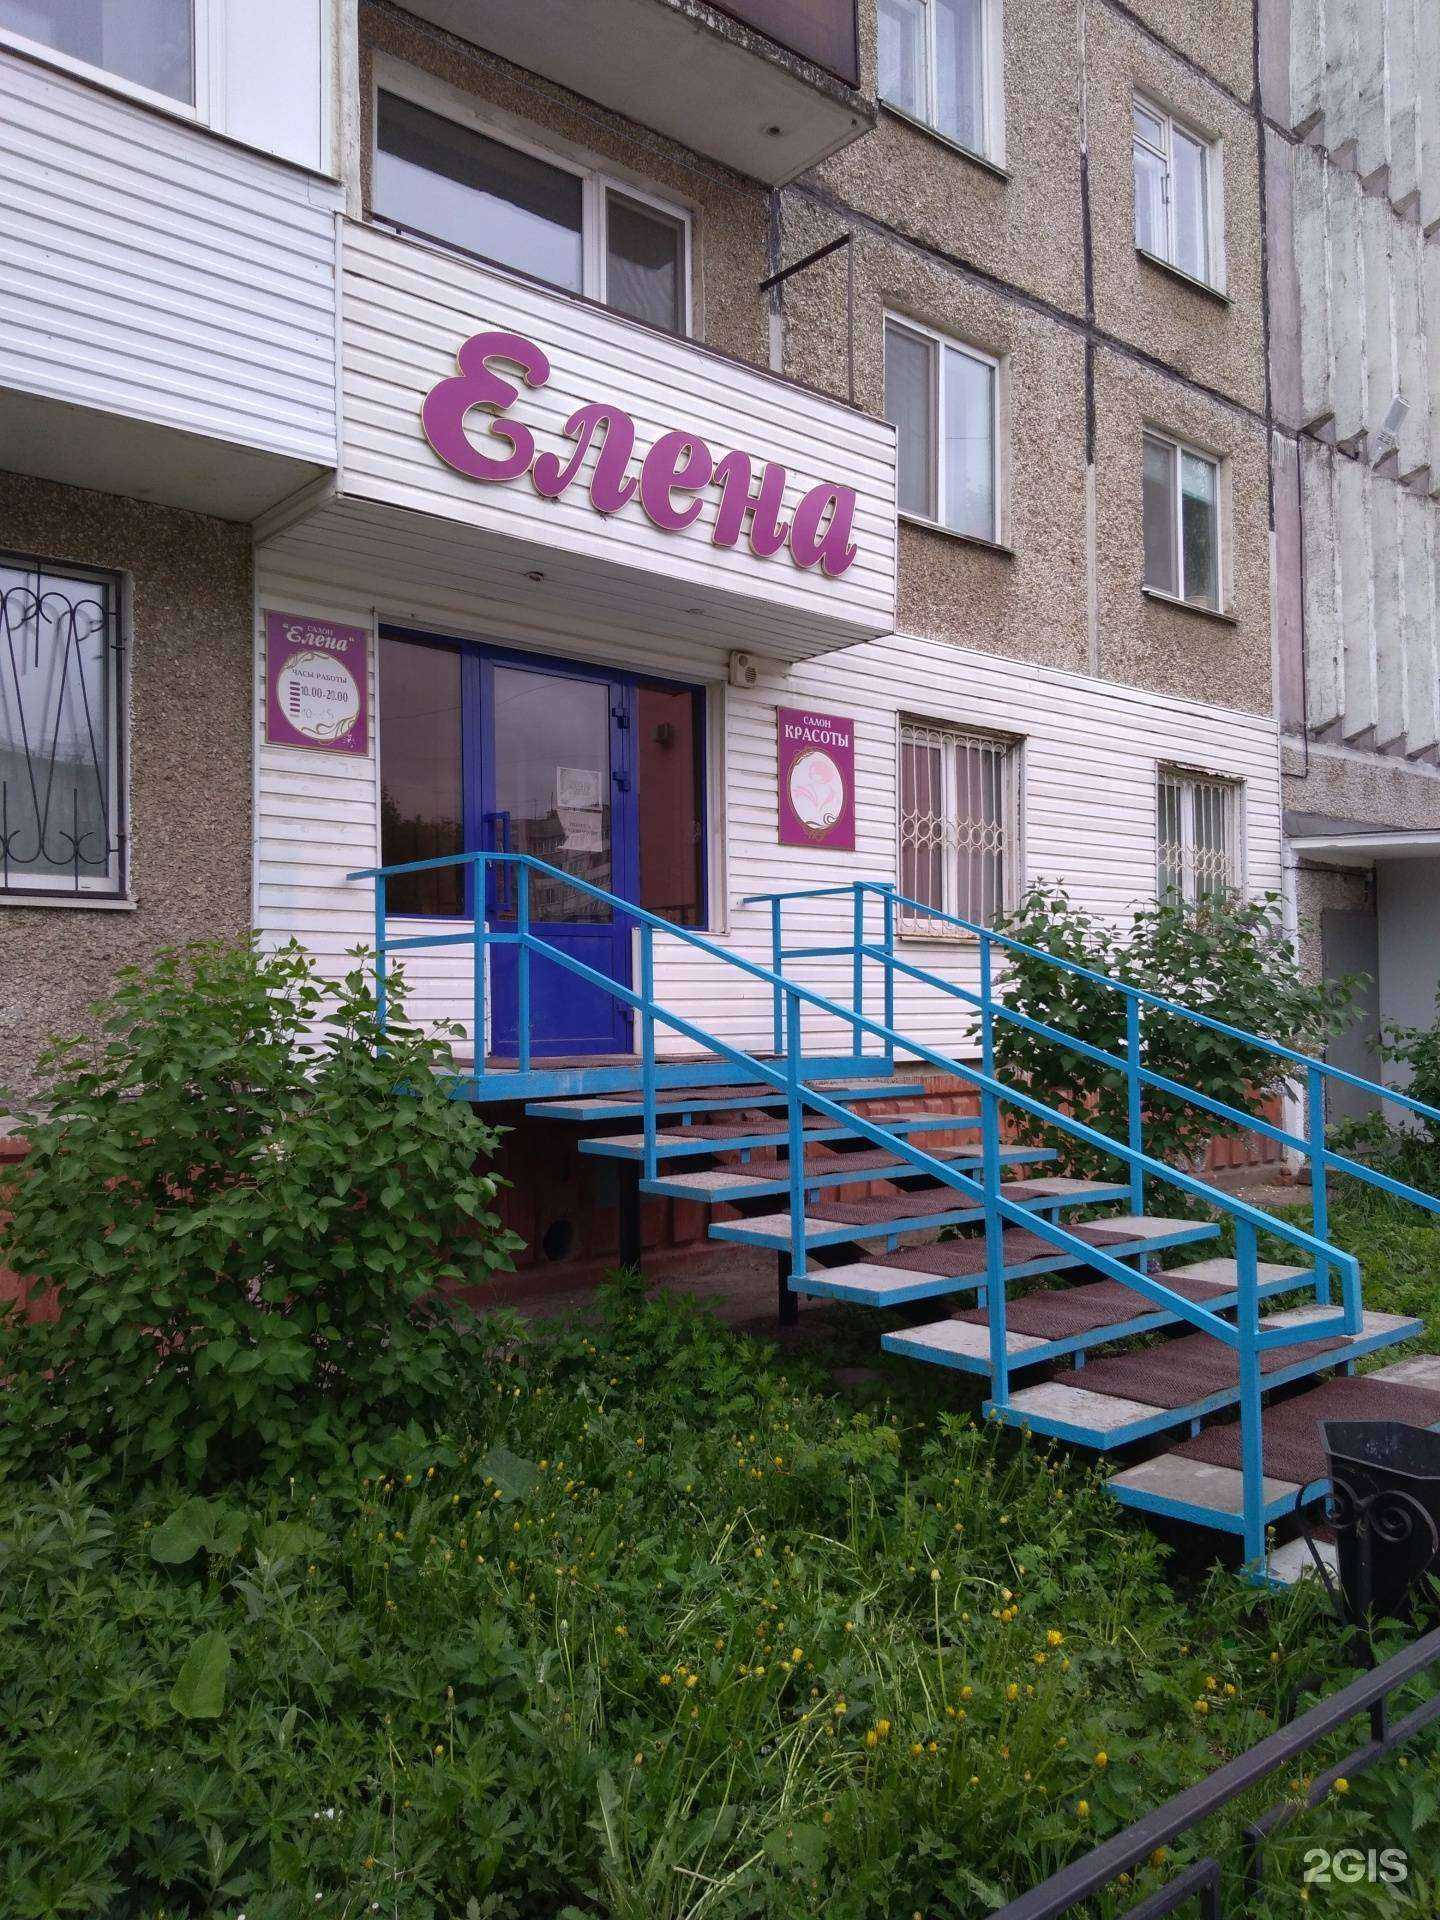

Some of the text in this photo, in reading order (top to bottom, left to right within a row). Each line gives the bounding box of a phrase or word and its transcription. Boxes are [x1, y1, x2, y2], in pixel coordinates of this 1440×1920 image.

[421, 331, 858, 578] Елена
[306, 625, 334, 636] САЛОН
[292, 668, 347, 684] ЧАСЫ РАБОТЫ
[803, 716, 832, 728] САЛОН
[784, 724, 849, 748] КРАСОТЫ
